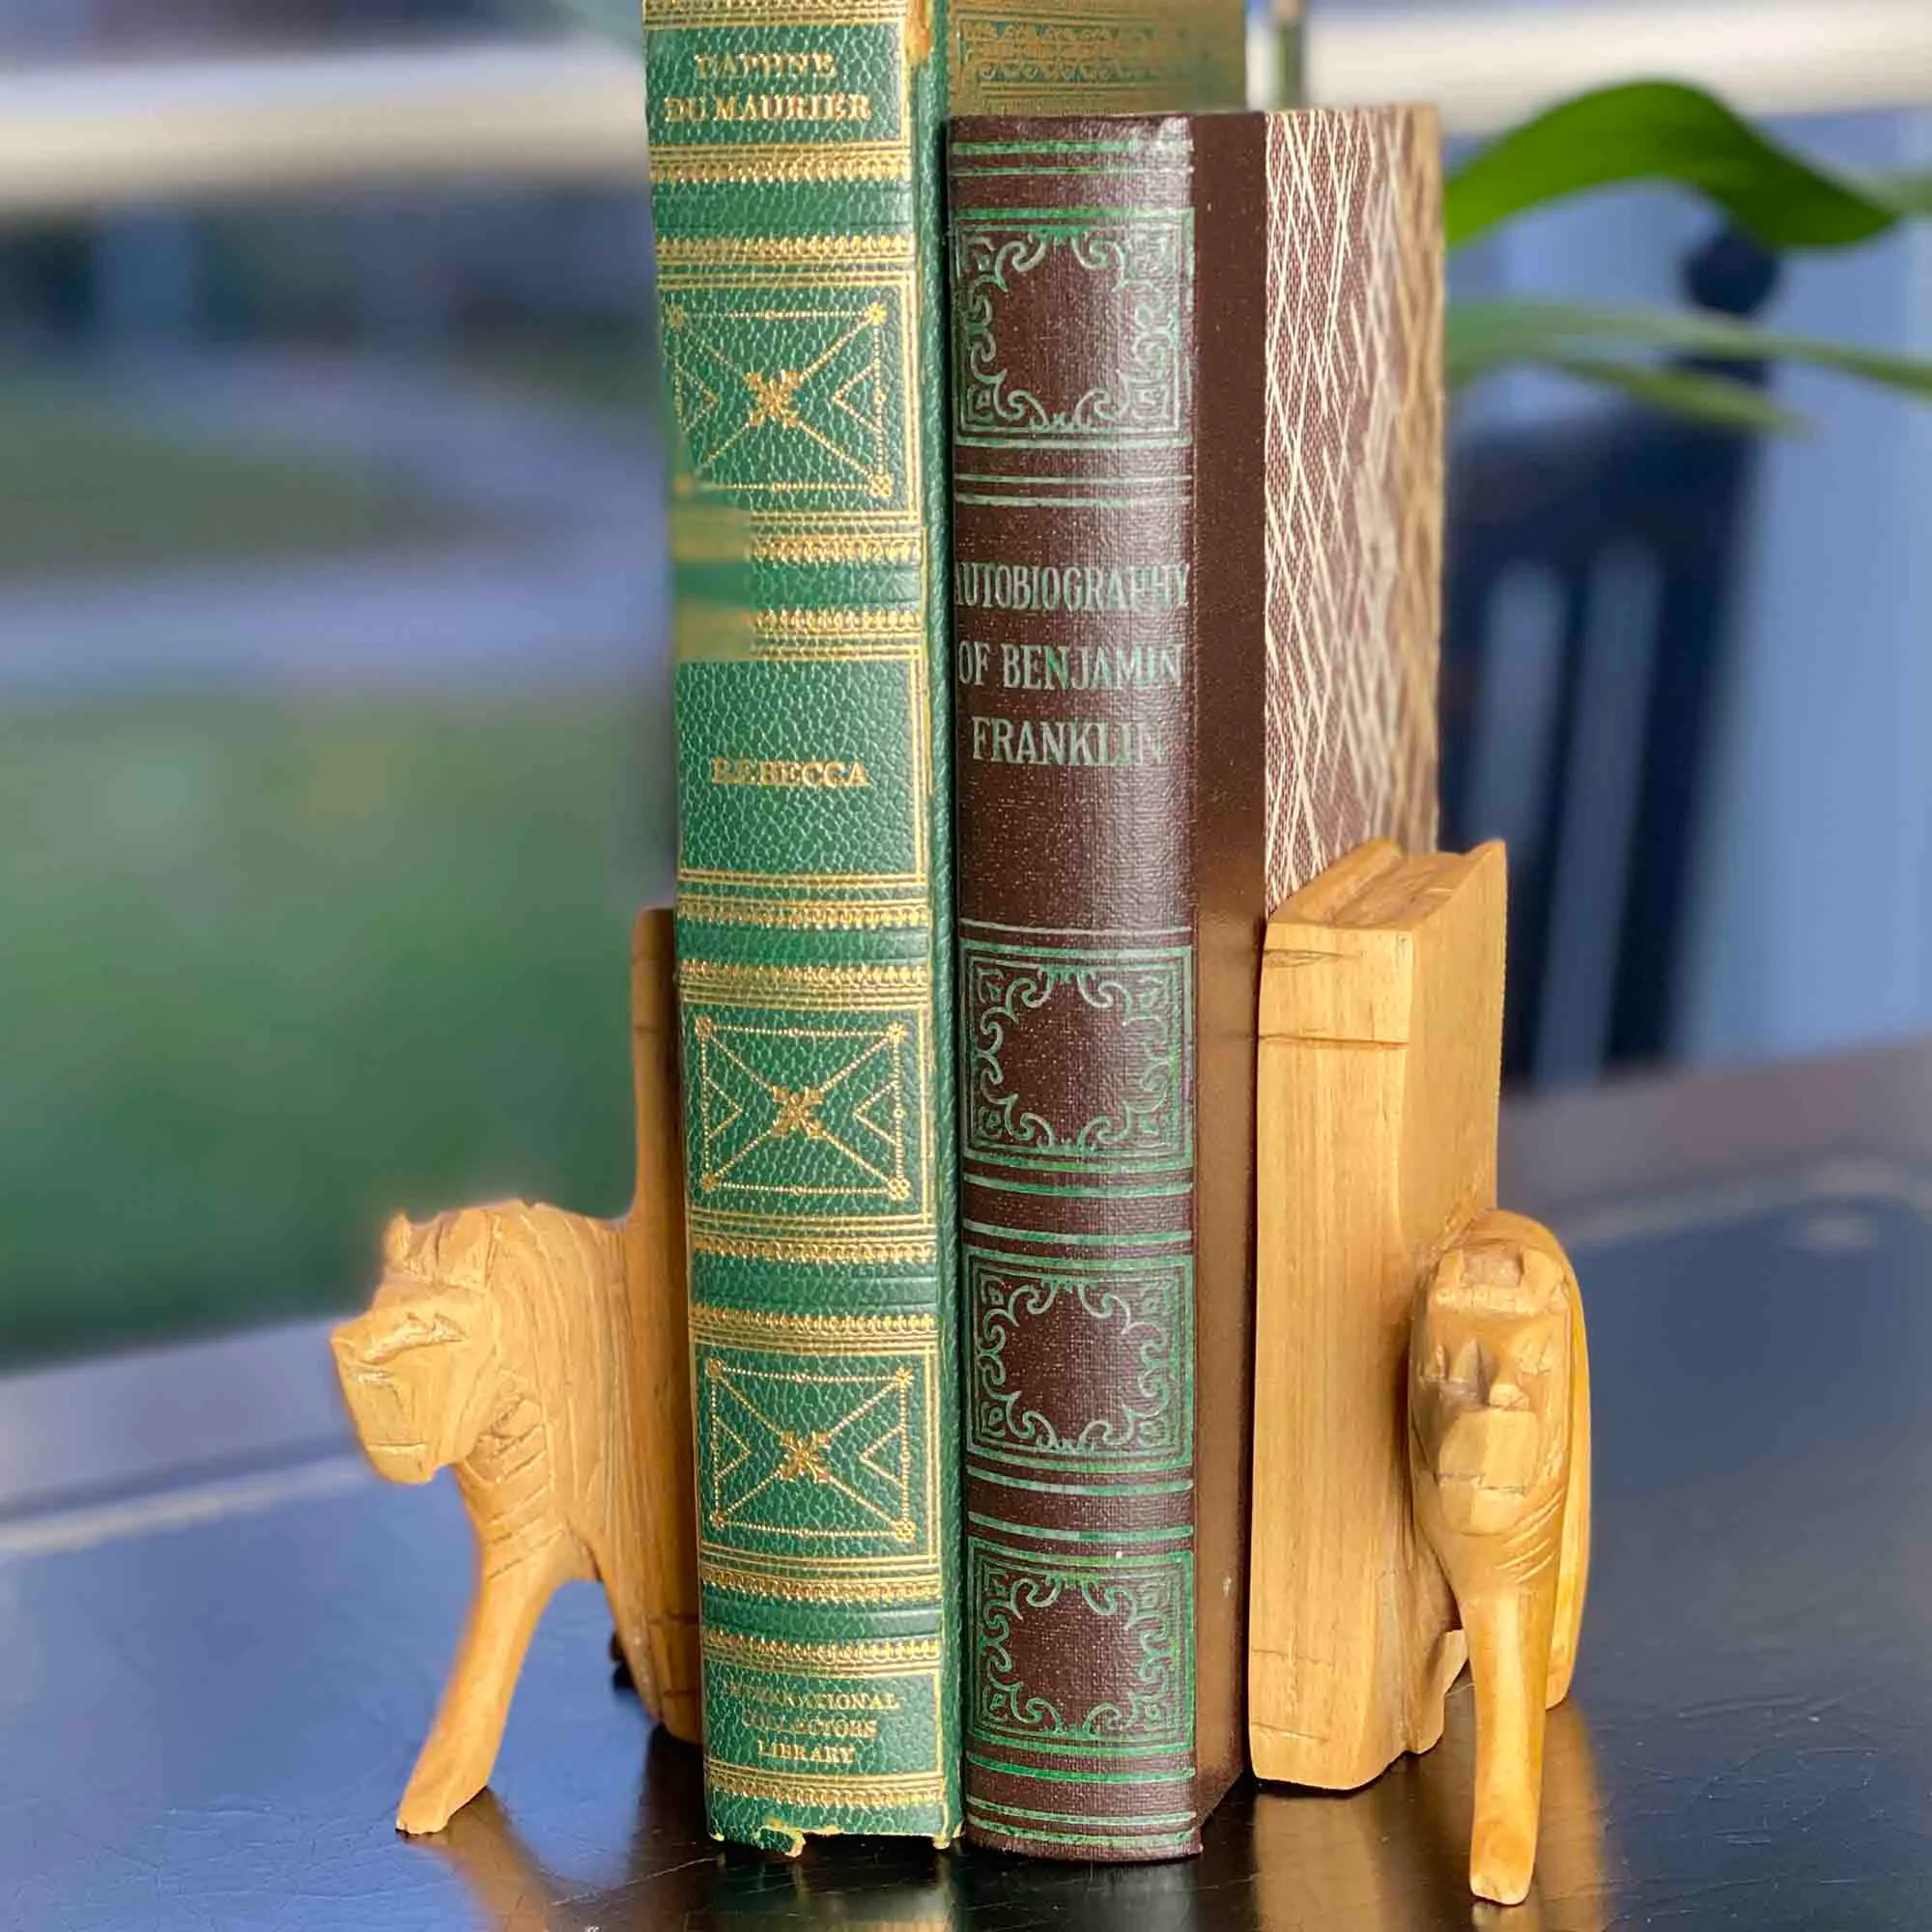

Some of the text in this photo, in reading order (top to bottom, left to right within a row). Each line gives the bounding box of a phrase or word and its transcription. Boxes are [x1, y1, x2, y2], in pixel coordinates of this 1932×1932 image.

[664, 93, 871, 122] DU MAURIER
[957, 639, 1186, 691] OF BENJAMIN
[971, 716, 1165, 767] FRANKLIN
[711, 756, 870, 789] REBECCA
